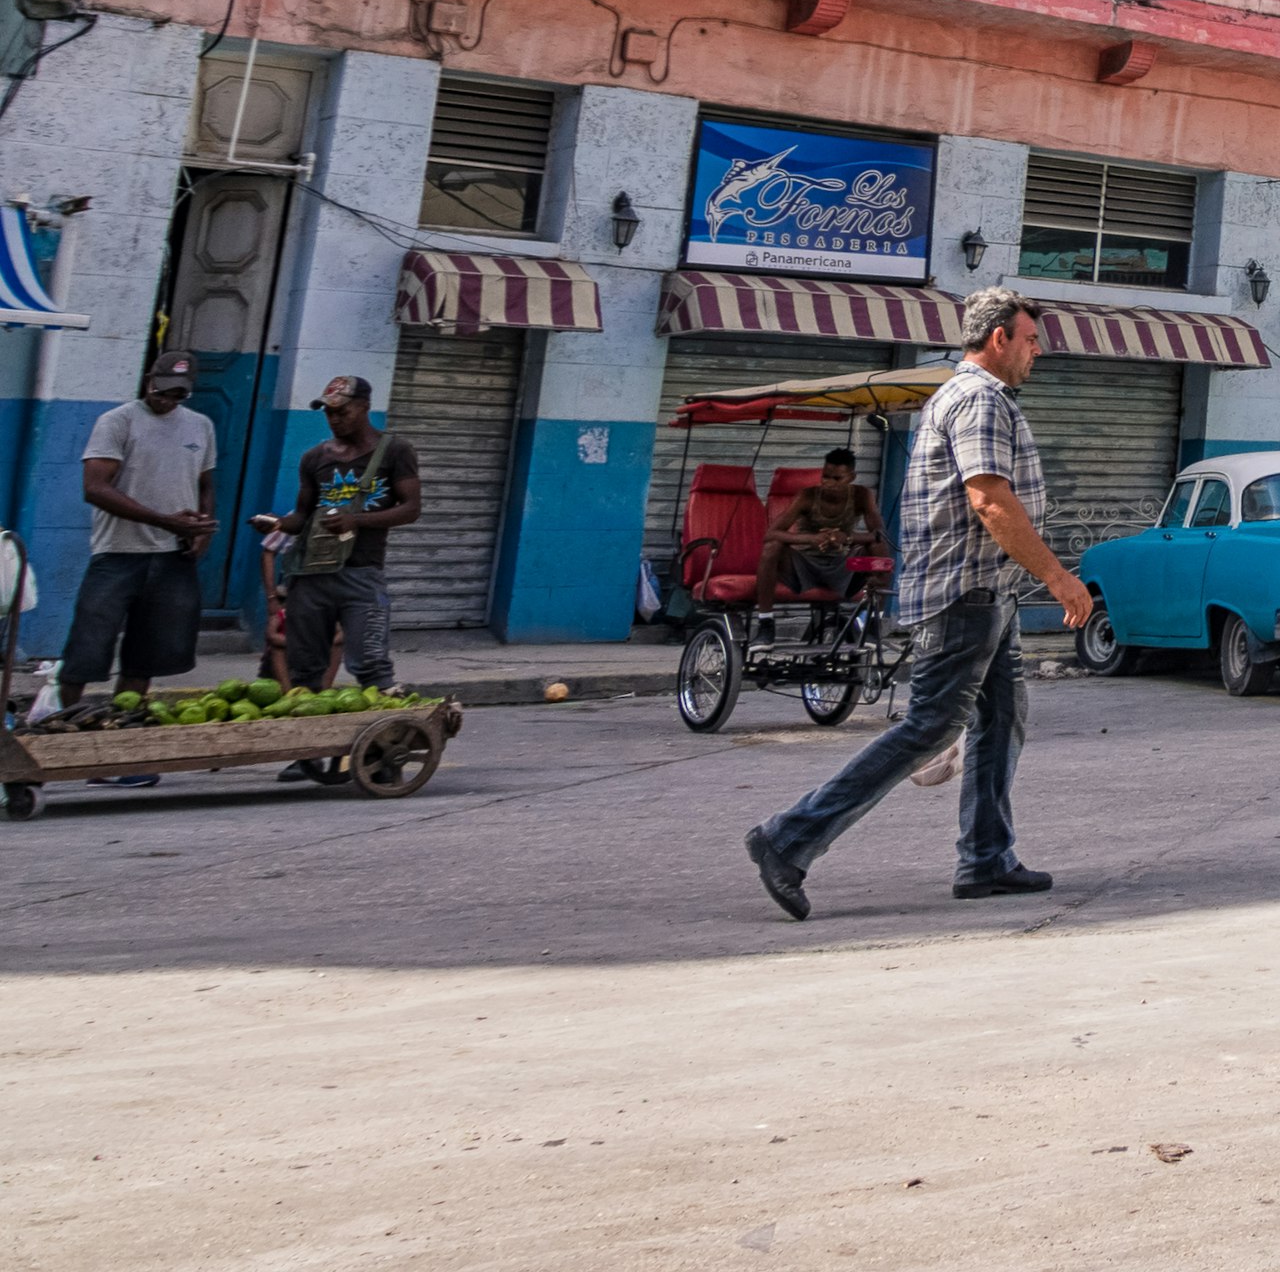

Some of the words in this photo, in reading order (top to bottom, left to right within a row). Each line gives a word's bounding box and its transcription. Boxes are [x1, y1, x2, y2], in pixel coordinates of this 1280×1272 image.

[846, 170, 907, 208] Los
[744, 173, 915, 238] Fornos
[746, 230, 908, 255] PESCADERIA
[762, 251, 852, 269] Panamericana
